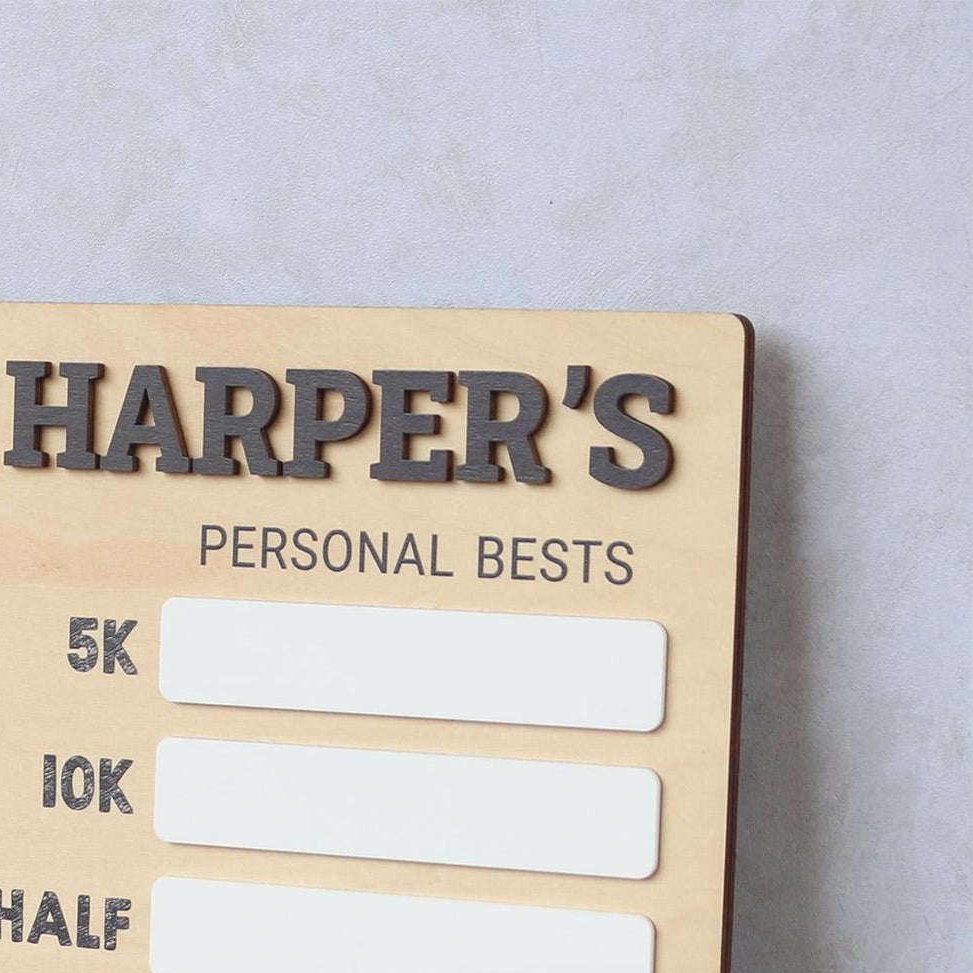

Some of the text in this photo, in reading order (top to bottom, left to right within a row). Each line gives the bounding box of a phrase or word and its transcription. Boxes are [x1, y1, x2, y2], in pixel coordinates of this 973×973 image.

[3, 360, 678, 492] HARPER'S
[200, 524, 635, 586] PERSONAL BESTS
[67, 616, 139, 676] 5K
[42, 754, 134, 815] 10K
